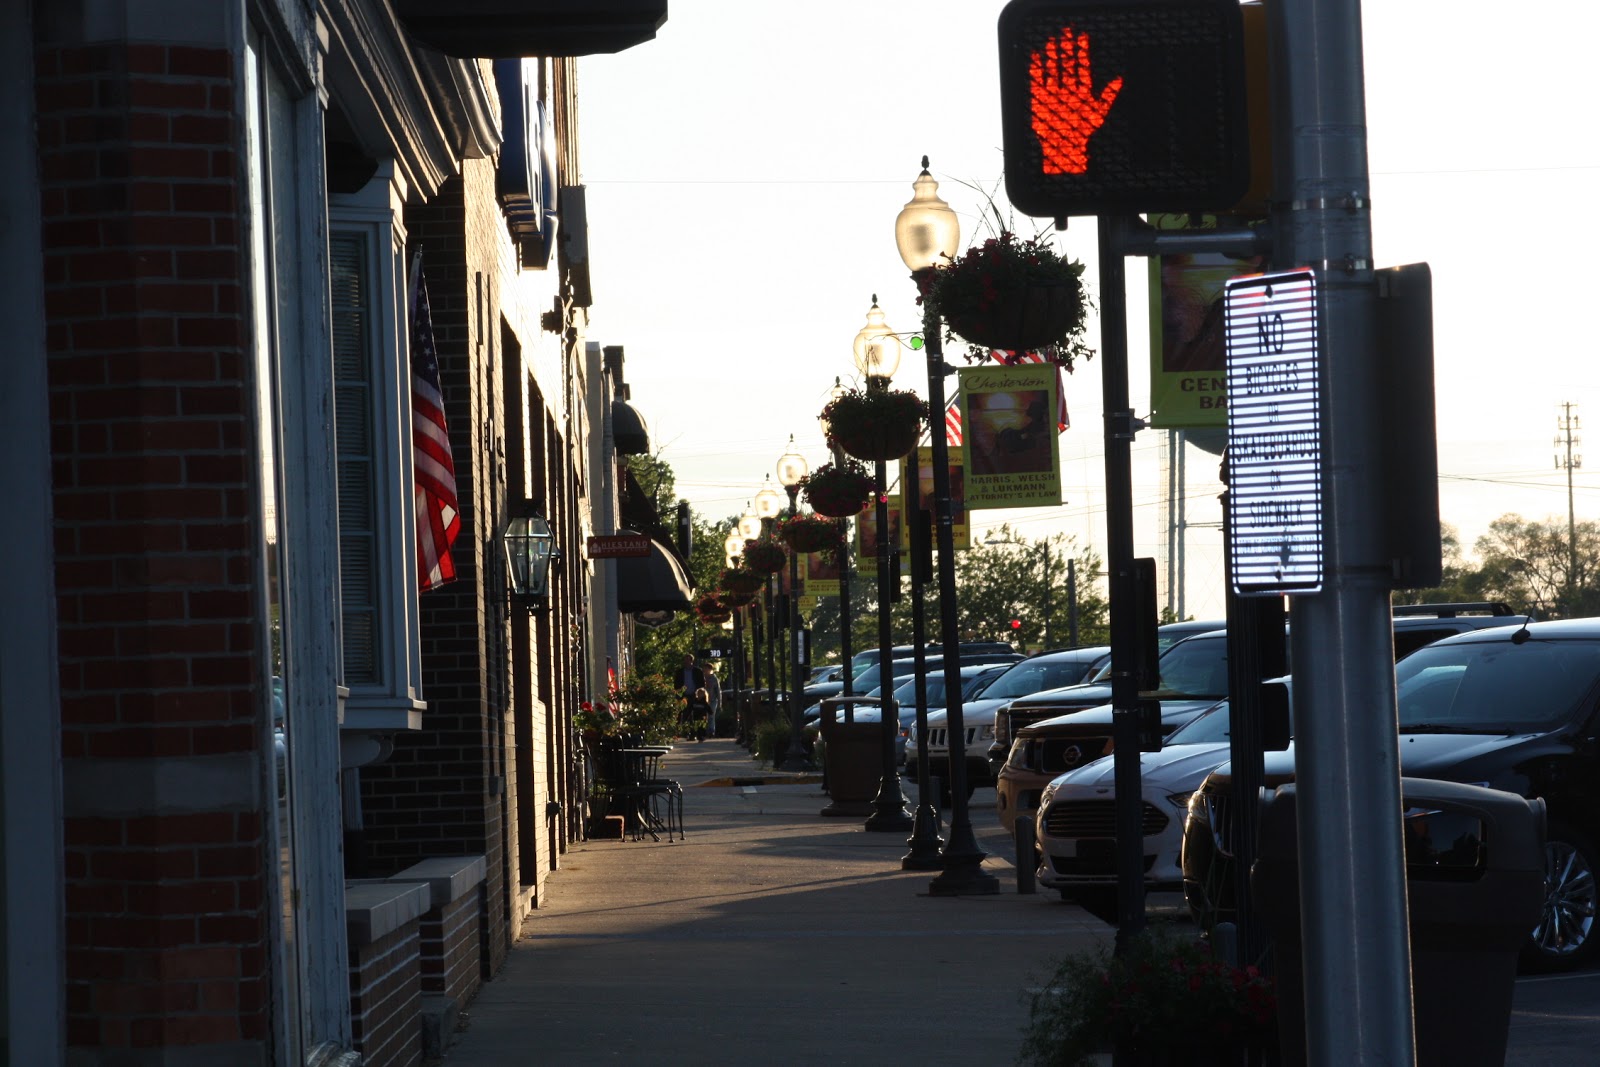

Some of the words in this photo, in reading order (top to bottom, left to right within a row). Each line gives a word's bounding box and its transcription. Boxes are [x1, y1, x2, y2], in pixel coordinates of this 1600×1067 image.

[1258, 312, 1284, 355] NO
[964, 375, 1047, 391] Chesterton
[1246, 362, 1299, 395] BICYCLES
[1268, 401, 1279, 423] OR
[1234, 431, 1314, 462] SKATEBOARDS
[1018, 473, 1055, 482] WELSH
[1270, 469, 1281, 490] ON
[981, 485, 989, 493] &
[992, 482, 1046, 493] LUKMANN
[970, 493, 1023, 501] ATTORNEY'S
[1250, 499, 1303, 528] SIDEWALK
[601, 540, 648, 549] HIESTAND
[710, 649, 721, 657] 3RD
